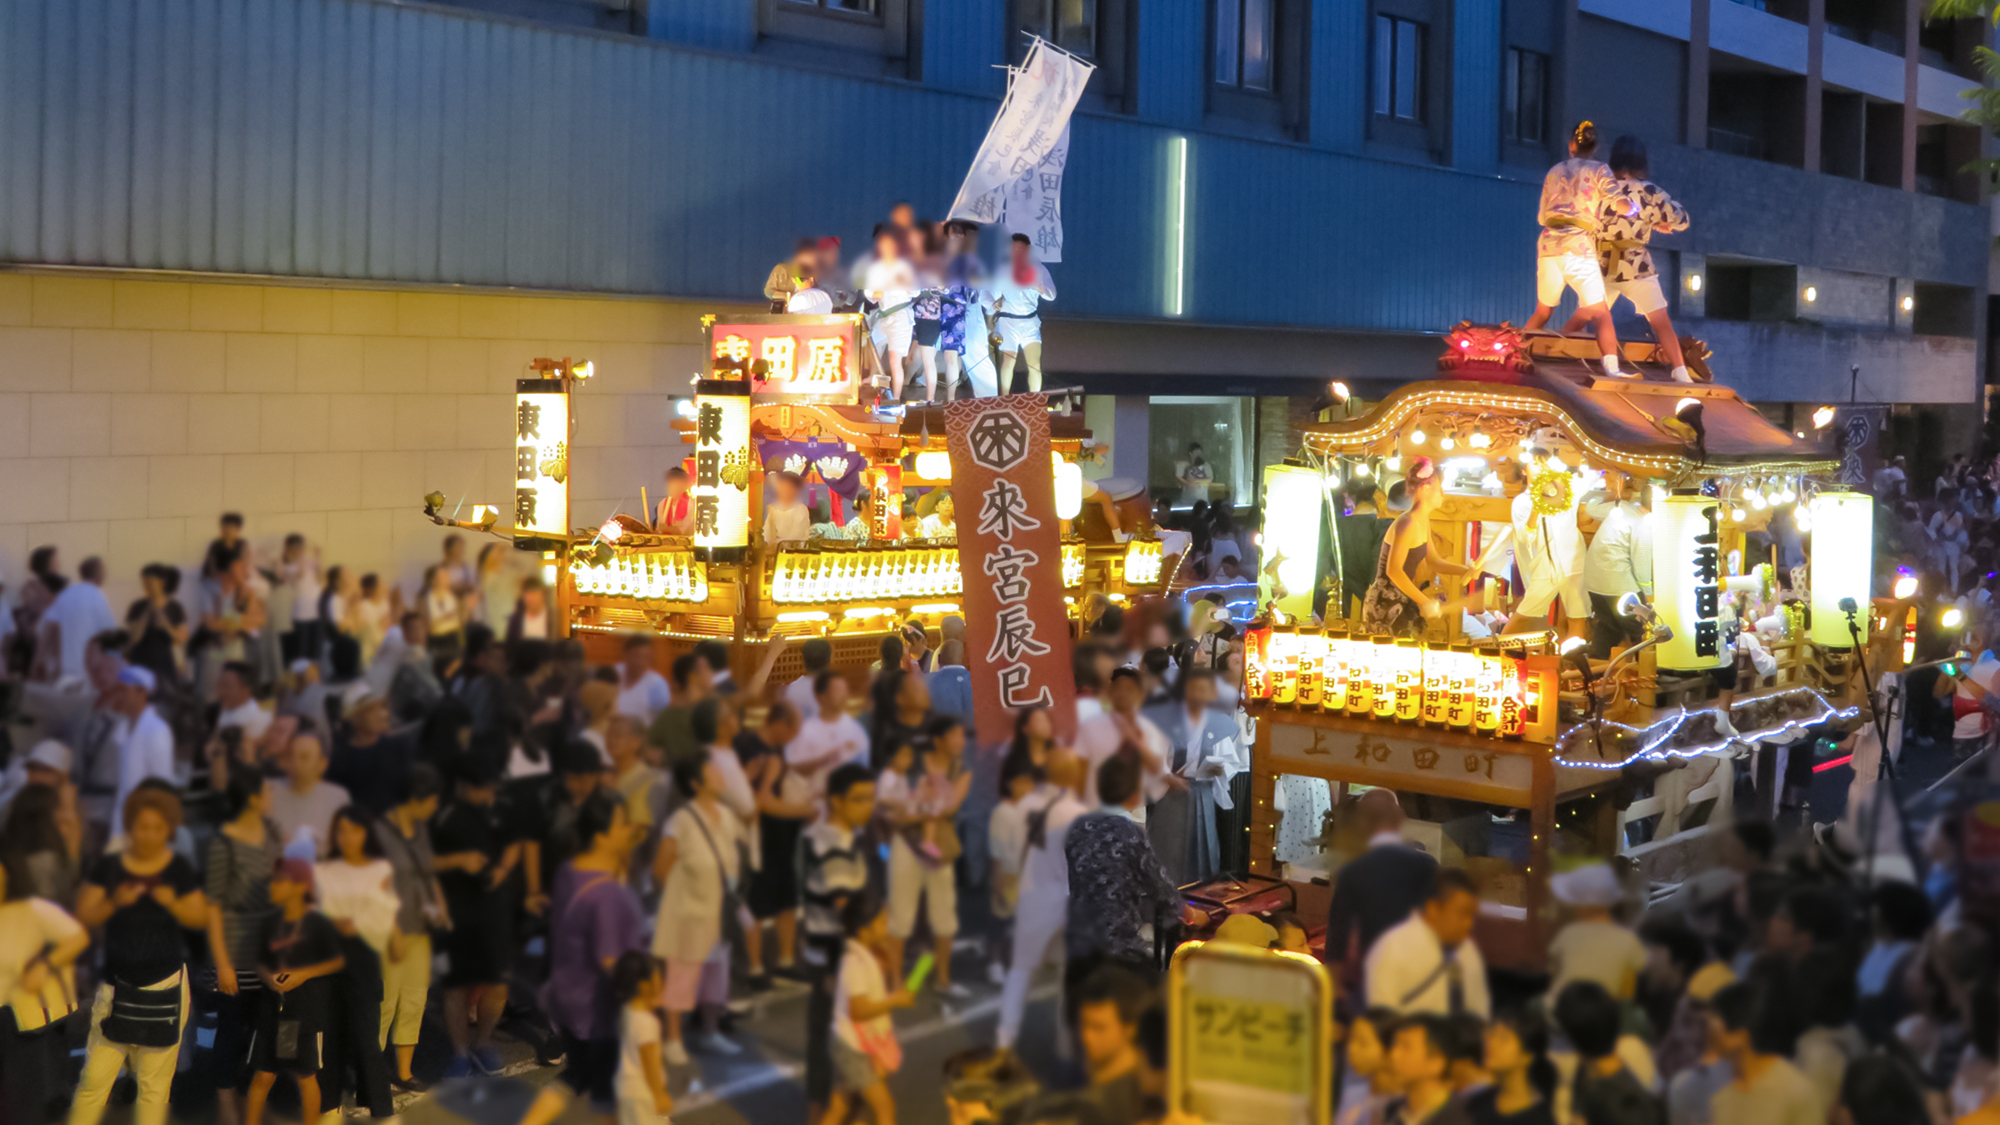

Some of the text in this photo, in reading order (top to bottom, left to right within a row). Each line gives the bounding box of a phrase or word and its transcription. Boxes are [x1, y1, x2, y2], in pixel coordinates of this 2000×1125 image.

[515, 399, 542, 528] 東田原
[696, 401, 724, 538] 東田原
[1303, 727, 1501, 780] 上和田町
